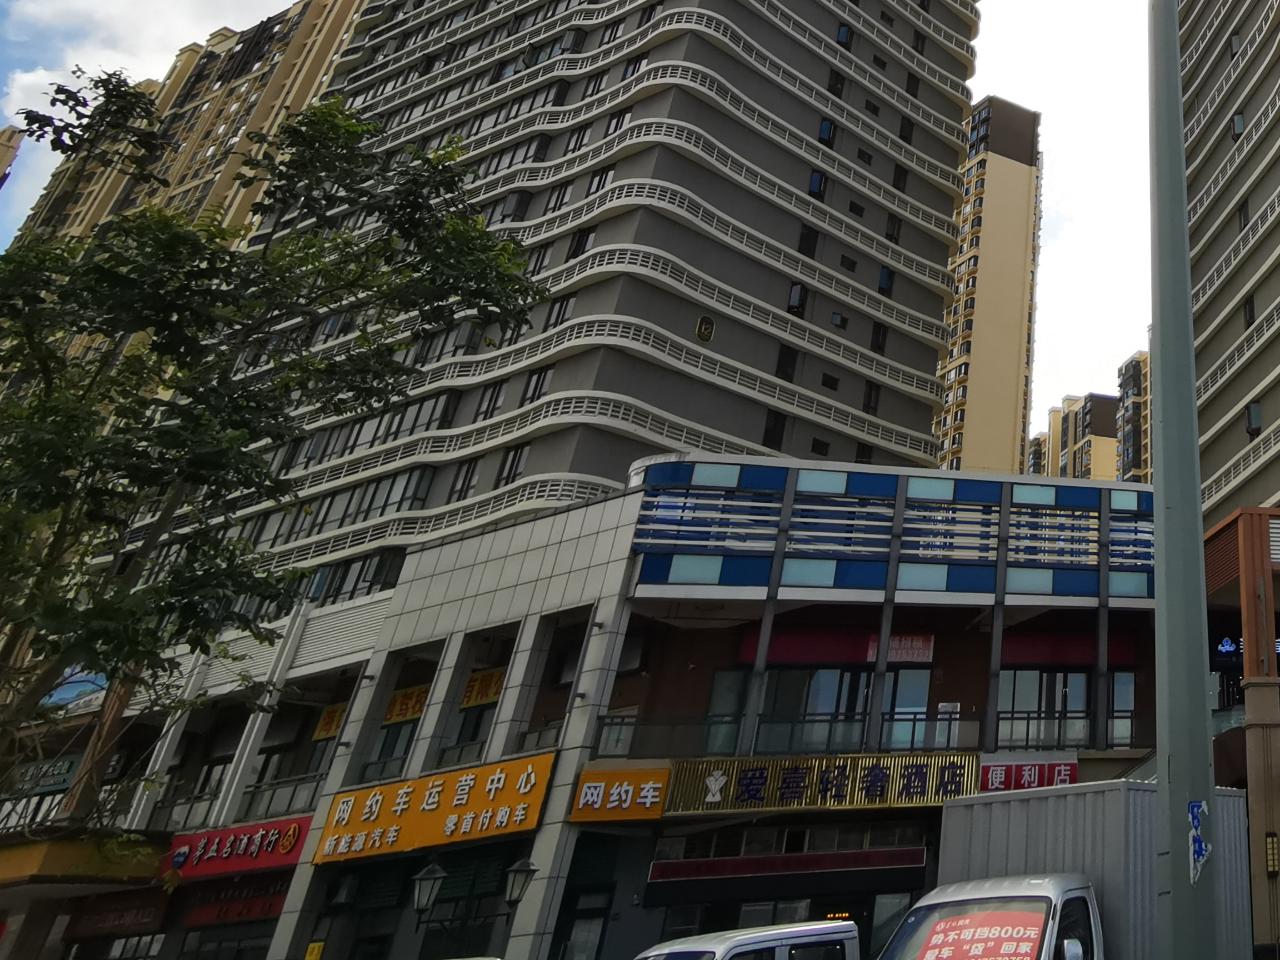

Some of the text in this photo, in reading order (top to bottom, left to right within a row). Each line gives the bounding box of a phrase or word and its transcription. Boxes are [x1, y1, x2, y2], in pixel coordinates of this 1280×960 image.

[735, 762, 965, 803] 爱喜轻奢酒店
[988, 765, 1071, 789] 便利店
[333, 764, 537, 827] 网约车运营中心
[578, 781, 663, 809] 网约车
[443, 802, 530, 837] 零首付购车
[323, 824, 402, 857] 新能源汽车
[928, 926, 1040, 947] 势不可挡800元
